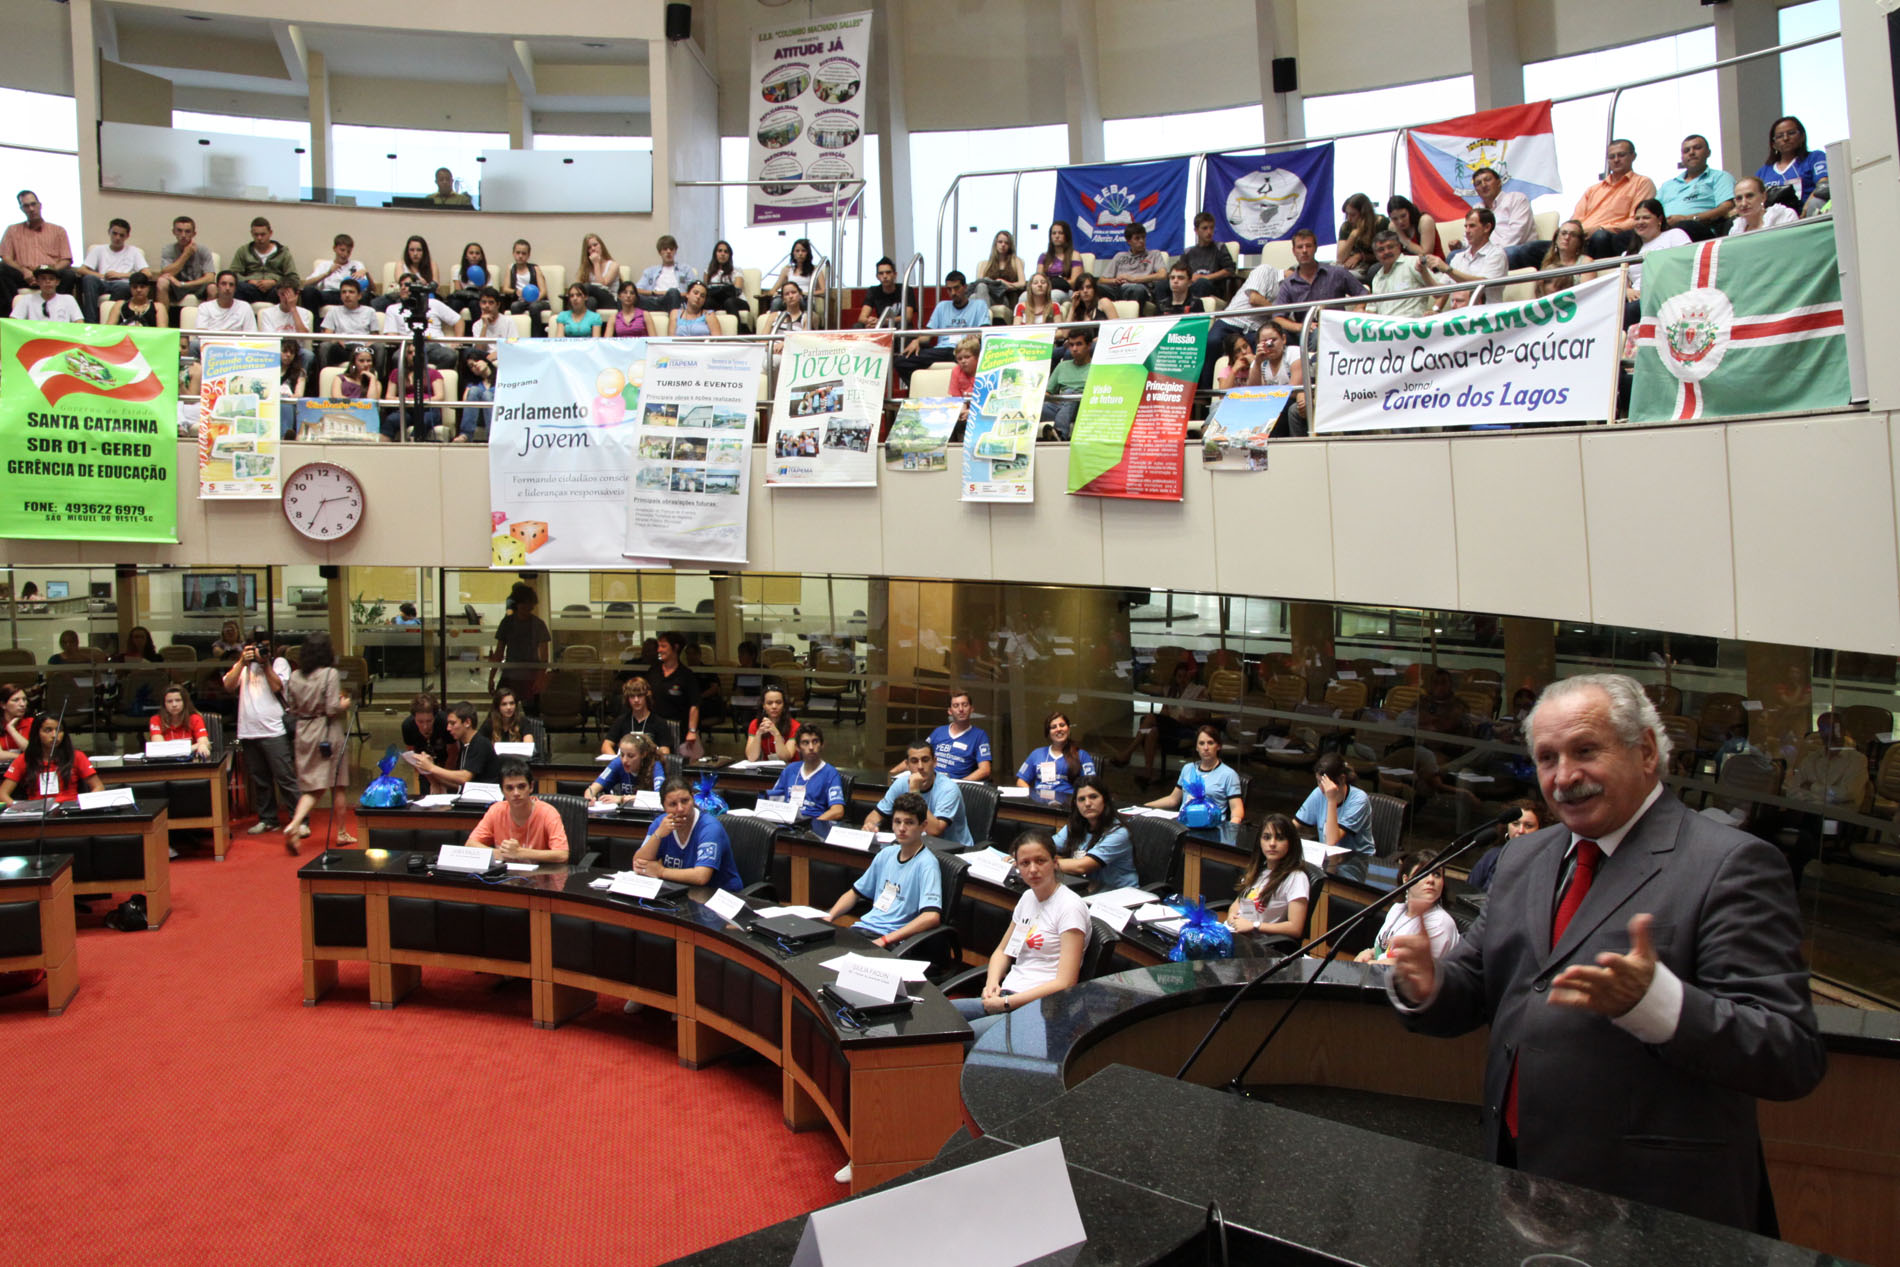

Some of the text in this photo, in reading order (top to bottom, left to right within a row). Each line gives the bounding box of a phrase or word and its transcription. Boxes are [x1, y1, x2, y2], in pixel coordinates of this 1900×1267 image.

[774, 36, 844, 60] ATITUDE JÁ
[1167, 333, 1196, 345] Missão
[1329, 332, 1596, 376] Terra da Cana-de-açúcar
[786, 353, 883, 388] Jovem
[497, 378, 538, 389] Programa
[656, 380, 693, 388] TURISMO
[703, 380, 744, 389] EVENTOS
[1146, 380, 1184, 393] Princípios
[1403, 381, 1433, 392] Jornal
[1152, 391, 1182, 402] valores
[1343, 389, 1378, 401] Apoio:
[1382, 382, 1570, 411] Correio dos Lagos
[494, 402, 588, 422] Parlamento
[27, 412, 158, 434] SANTA CATARINA
[27, 437, 63, 453] SDR
[101, 442, 151, 457] GERED
[517, 427, 590, 457] Jovem
[8, 459, 166, 482] GERÊNCIA DE EDUCAÇÃO
[318, 469, 329, 477] 12
[336, 474, 341, 482] 1
[512, 475, 557, 484] Formando
[558, 473, 597, 483] cidadãos
[295, 483, 307, 491] 10
[524, 489, 567, 498] lideranças
[570, 489, 625, 499] responsáveis
[24, 501, 145, 516] FONE: 493622 6979
[351, 499, 357, 507] 3
[45, 513, 61, 521] SÃO
